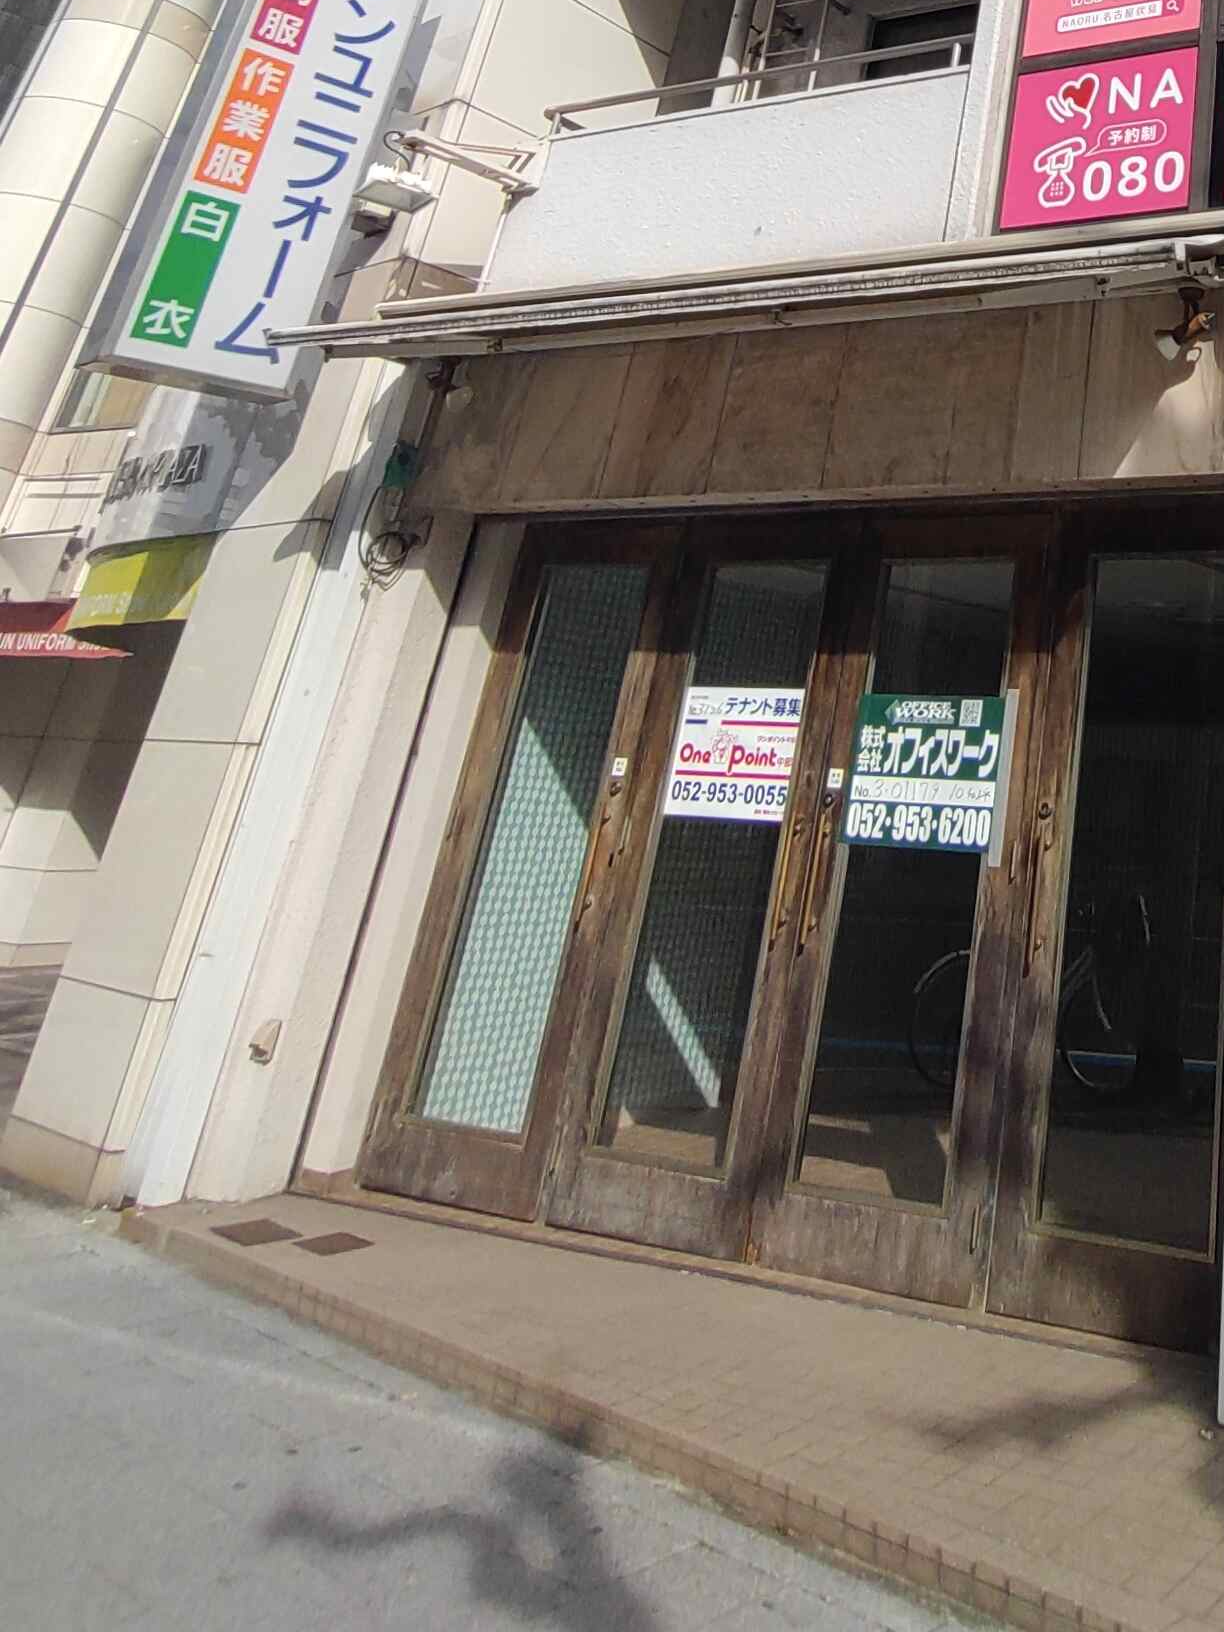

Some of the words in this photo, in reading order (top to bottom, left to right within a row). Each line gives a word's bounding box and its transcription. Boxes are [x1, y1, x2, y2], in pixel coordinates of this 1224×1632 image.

[1107, 68, 1184, 114] NA
[203, 57, 283, 187] 作業服
[1107, 125, 1158, 147] 予約制
[1082, 150, 1186, 202] 080
[725, 697, 801, 717] テナント募集
[895, 707, 957, 720] WORK
[882, 726, 1000, 778] オフィスワーク
[671, 780, 787, 806] 052-953-0055
